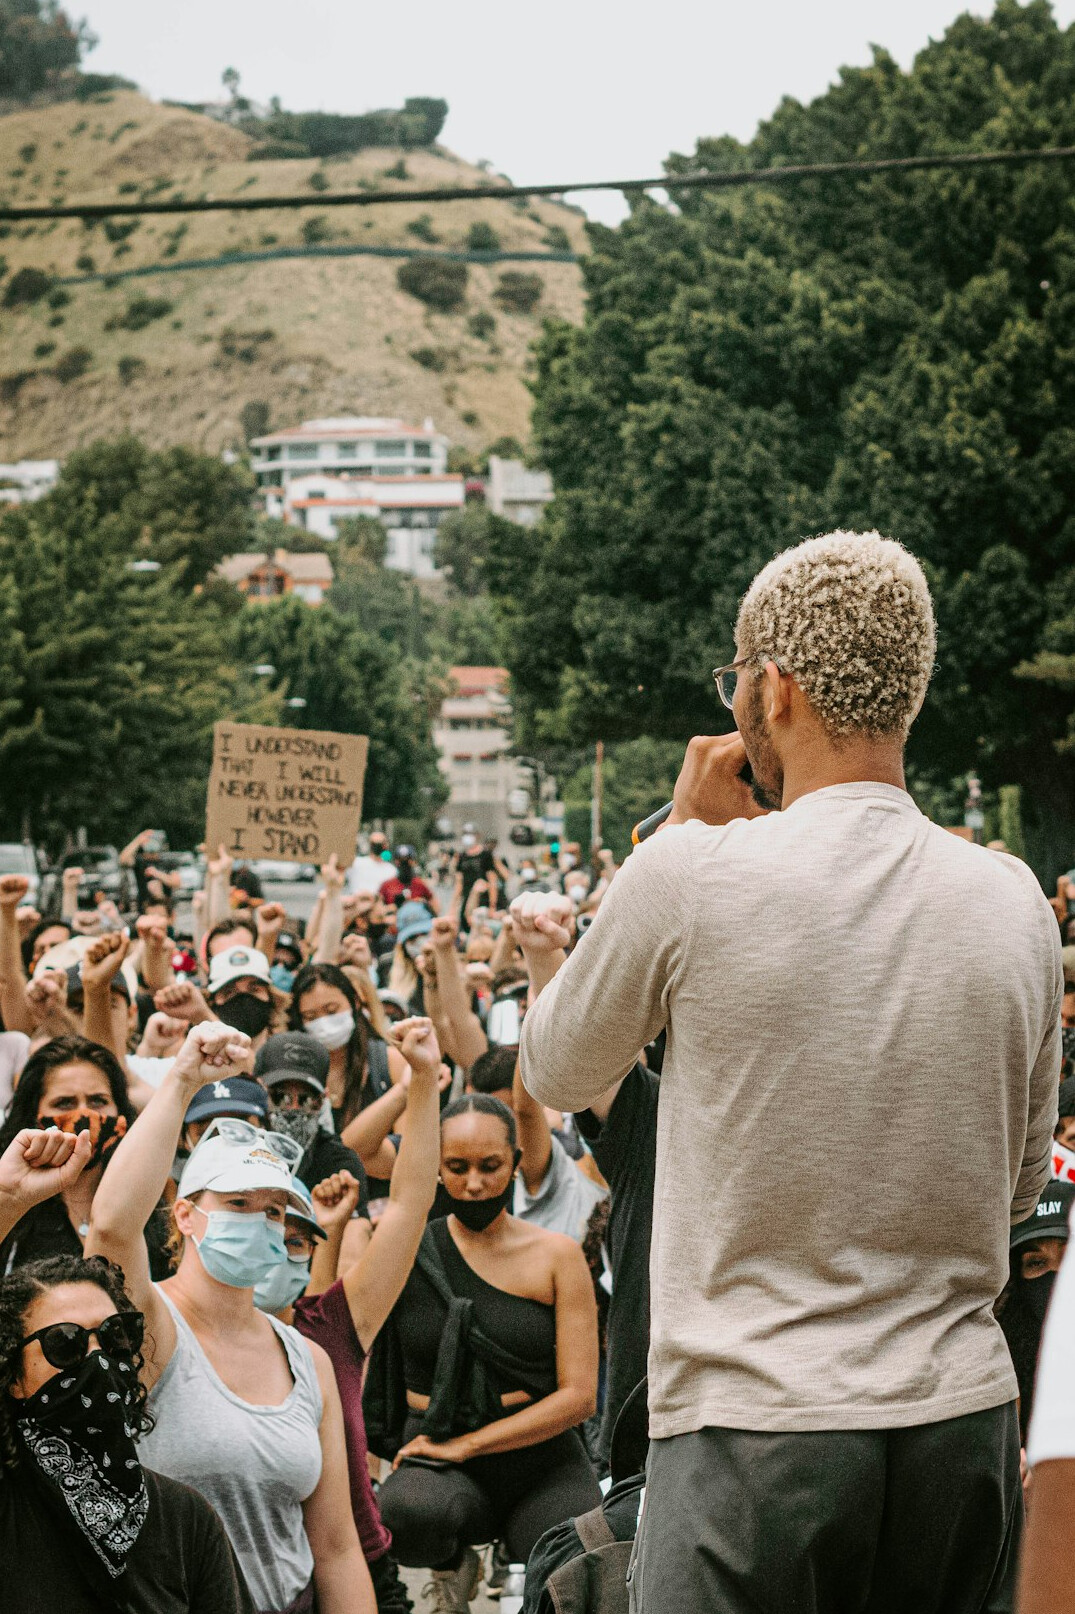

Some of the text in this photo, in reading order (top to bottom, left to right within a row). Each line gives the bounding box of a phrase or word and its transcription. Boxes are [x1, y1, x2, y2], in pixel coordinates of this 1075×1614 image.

[220, 733, 342, 761] I UNDERSTAND
[220, 756, 345, 785] THAT I WILL
[217, 780, 269, 800] NEVER
[247, 805, 318, 829] HOWEVER
[230, 827, 319, 855] I STAND
[1037, 1201, 1062, 1217] SLAY
